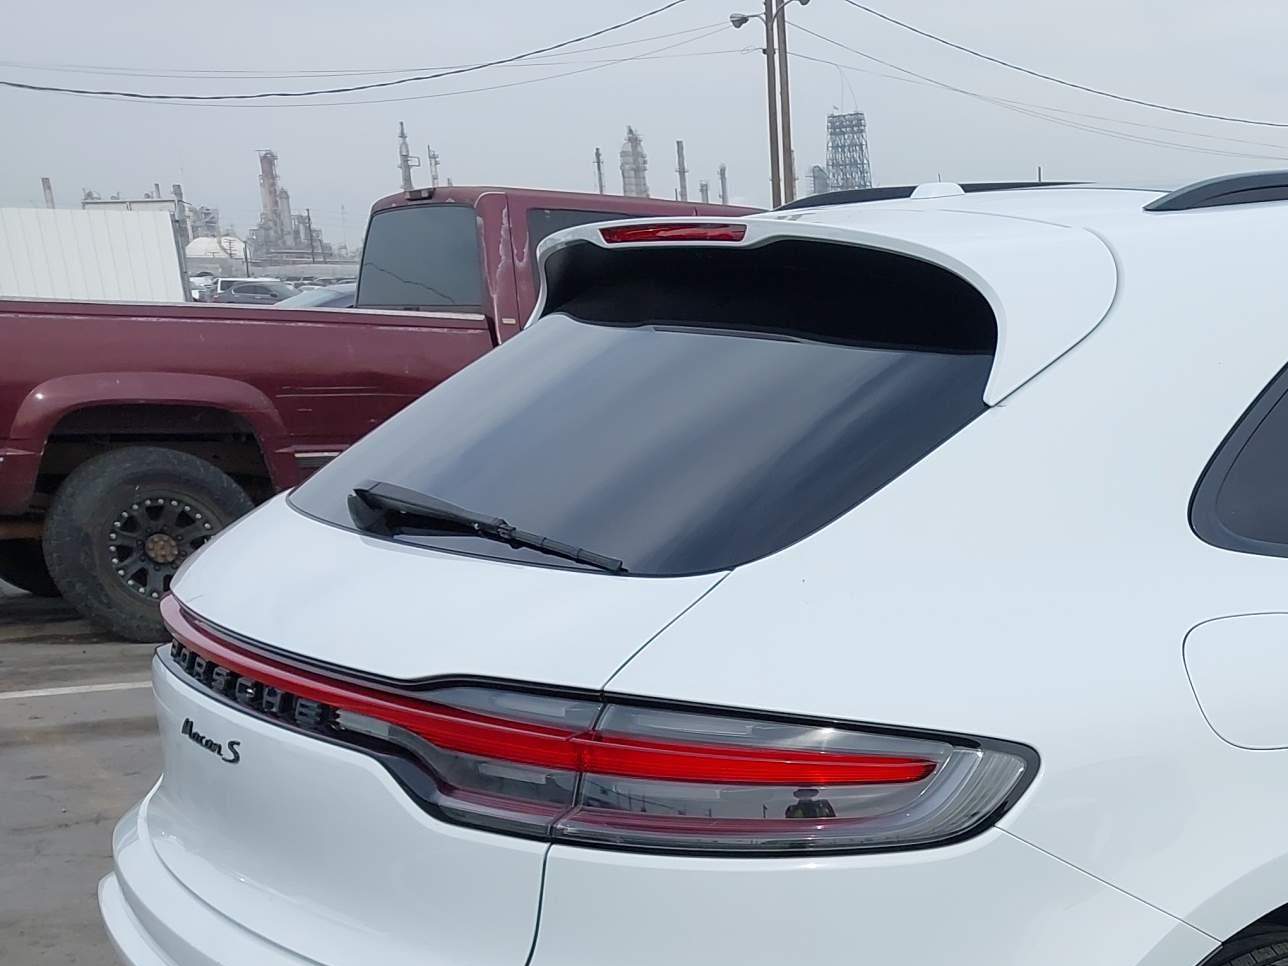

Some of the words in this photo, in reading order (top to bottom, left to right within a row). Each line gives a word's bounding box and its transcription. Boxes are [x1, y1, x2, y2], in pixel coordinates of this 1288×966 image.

[171, 639, 321, 725] PORSCHE
[181, 717, 224, 757] Macan
[222, 739, 241, 764] S
